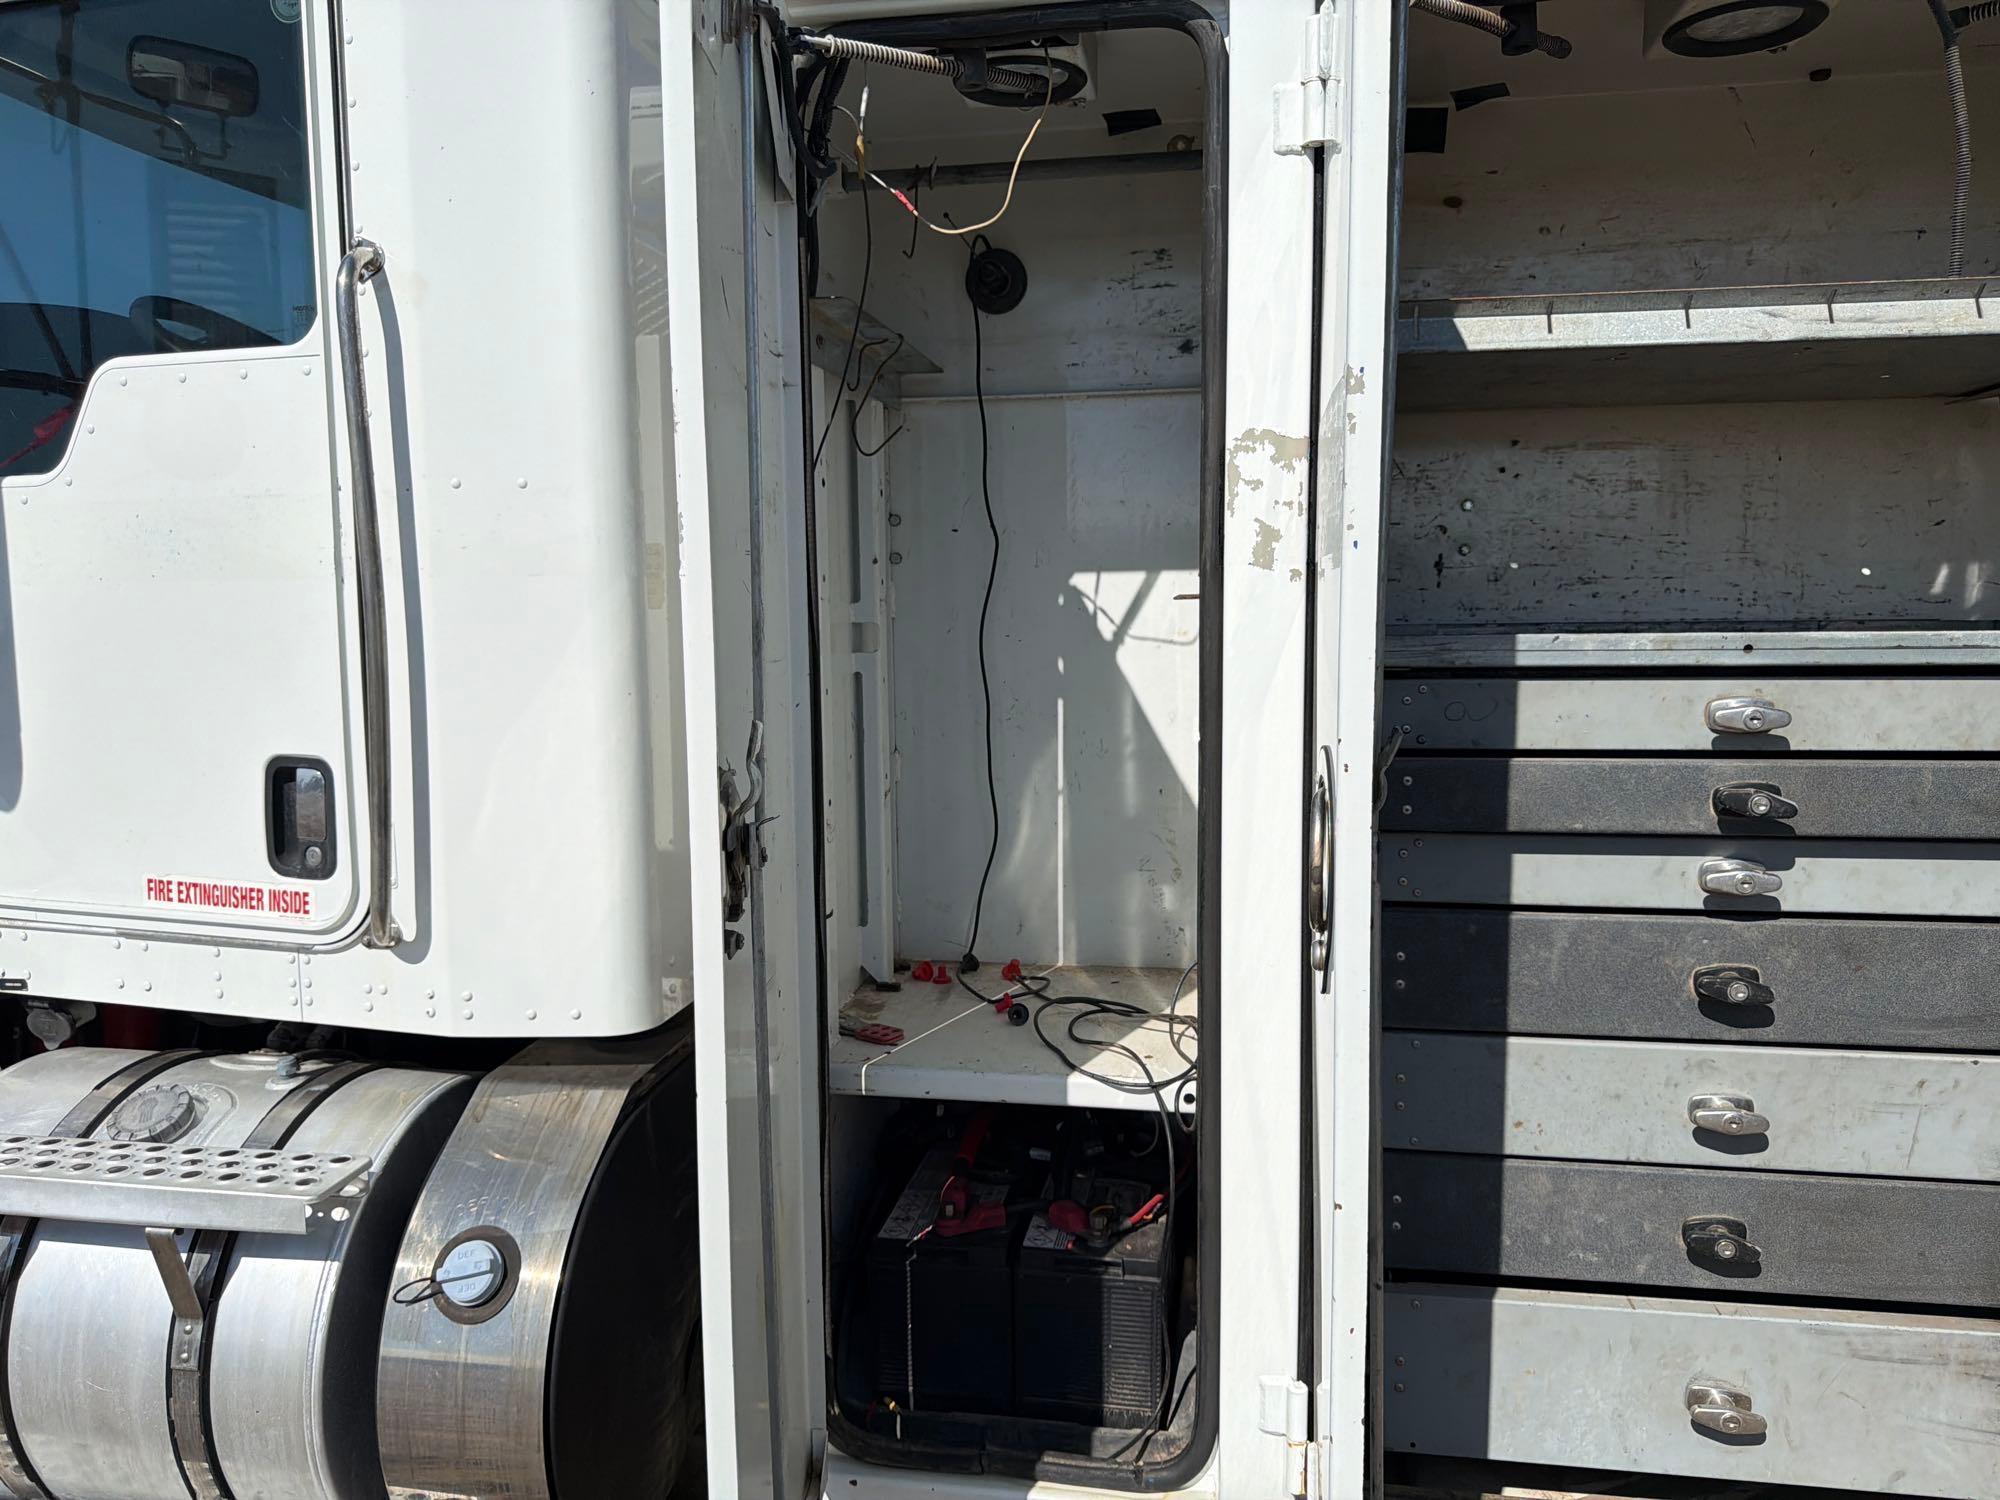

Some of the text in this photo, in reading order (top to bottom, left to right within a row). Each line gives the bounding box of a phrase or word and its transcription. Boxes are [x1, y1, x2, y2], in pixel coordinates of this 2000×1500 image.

[147, 878, 310, 915] FIRE EXTINGUISHER INSIDE
